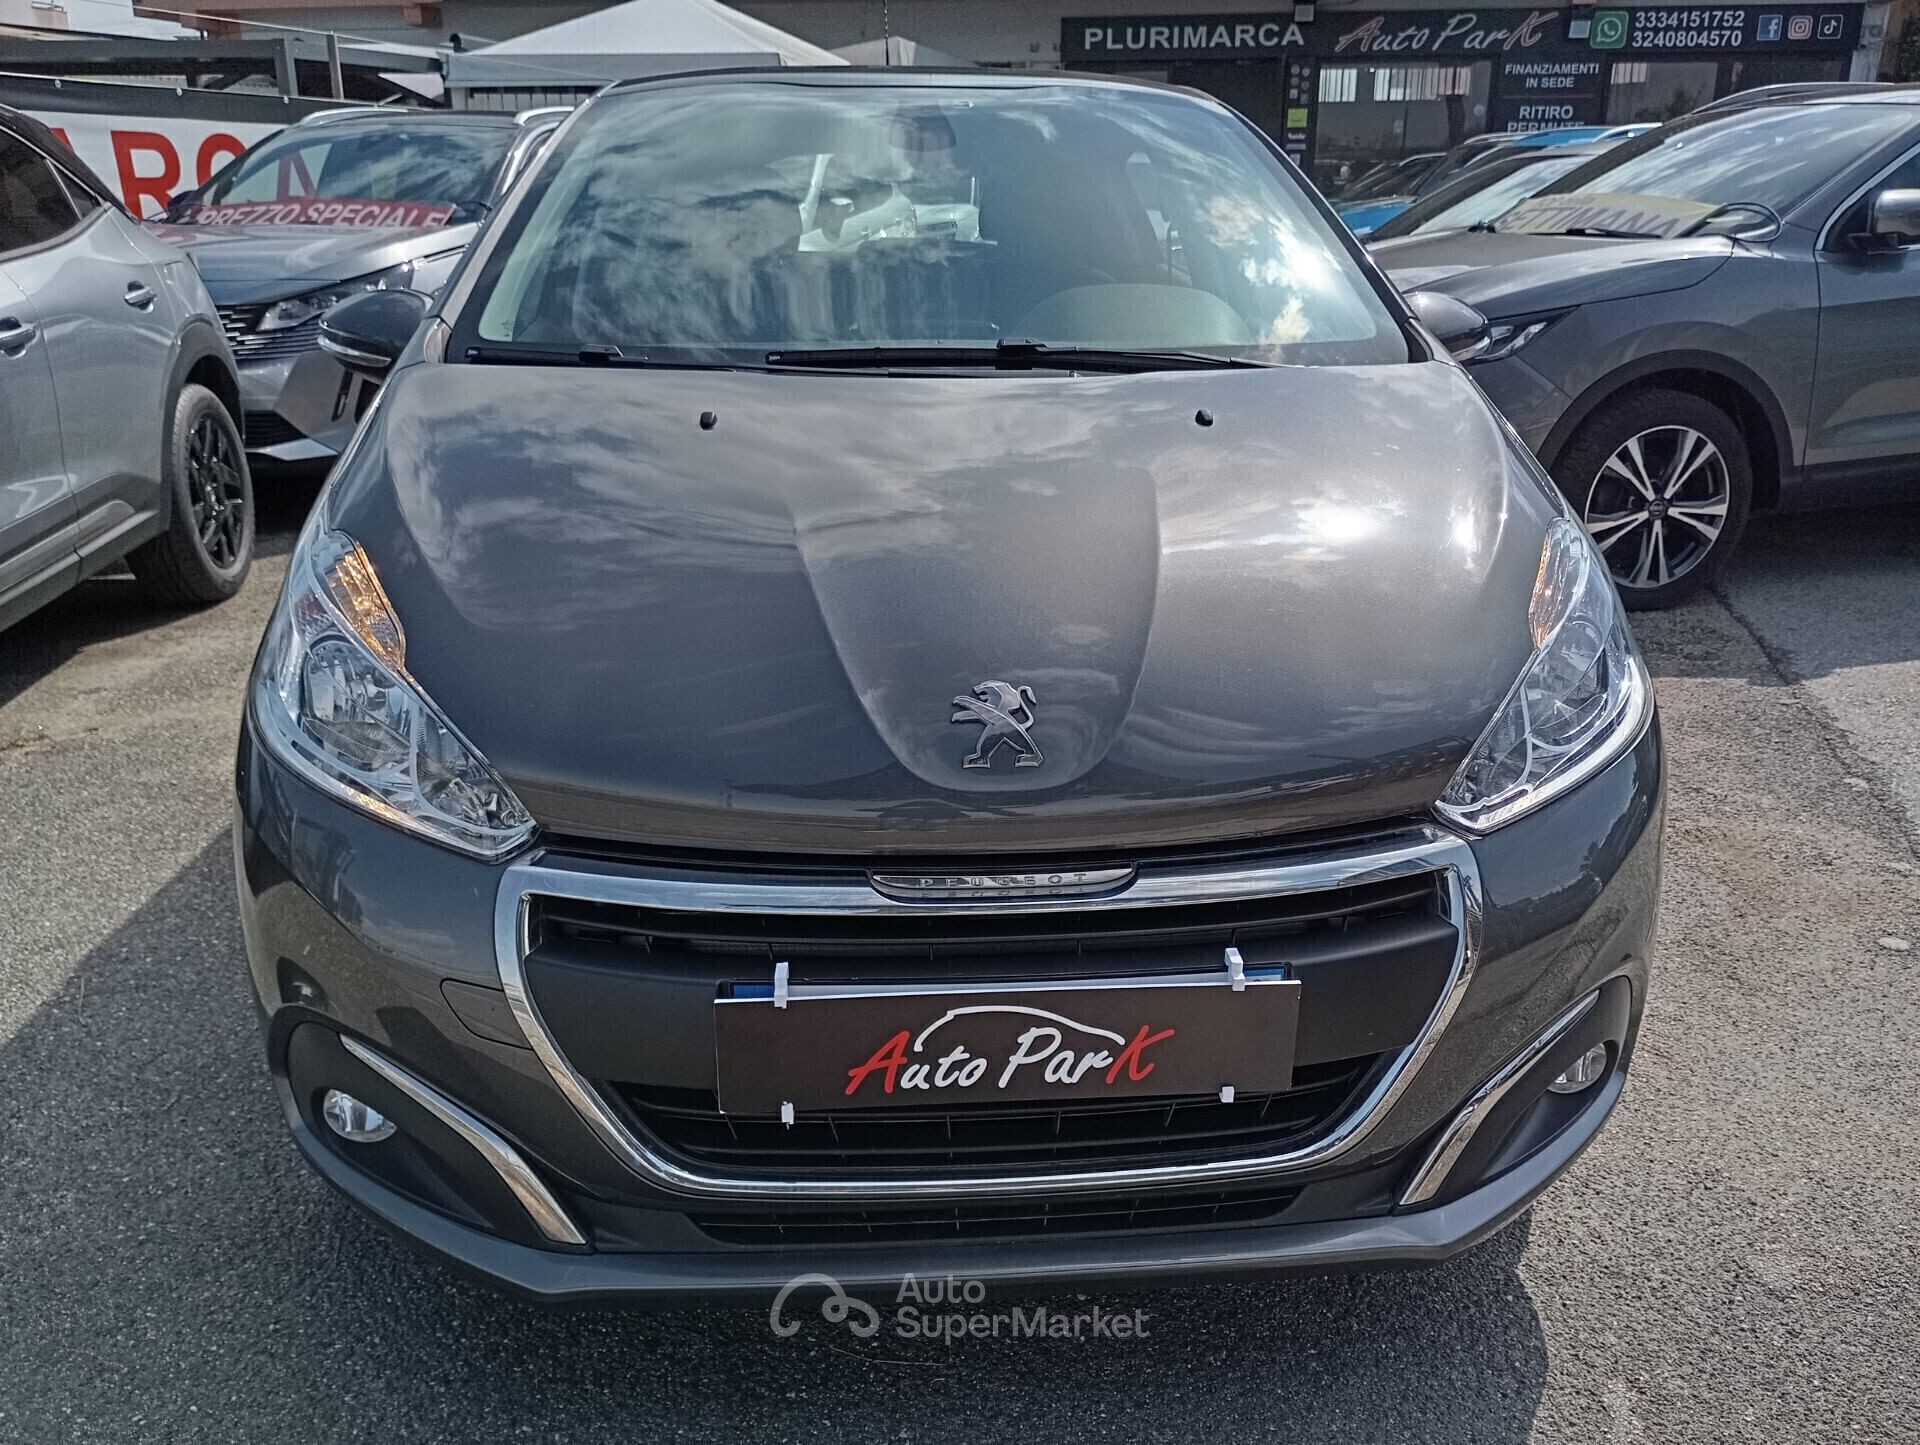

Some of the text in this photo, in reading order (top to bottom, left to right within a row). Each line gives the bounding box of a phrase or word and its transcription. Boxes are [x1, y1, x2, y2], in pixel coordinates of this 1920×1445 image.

[1635, 10, 1745, 28] 3334151752
[1084, 24, 1305, 50] PLURIMARCA
[1334, 16, 1430, 52] Auto
[1632, 30, 1742, 47] 3240804570
[1504, 63, 1599, 75] FINANZIAMENTI
[1525, 77, 1575, 88] IN SEDE
[1519, 105, 1574, 119] RITIRO
[918, 873, 1087, 888] PEUGEOT
[845, 1030, 988, 1095] Auto
